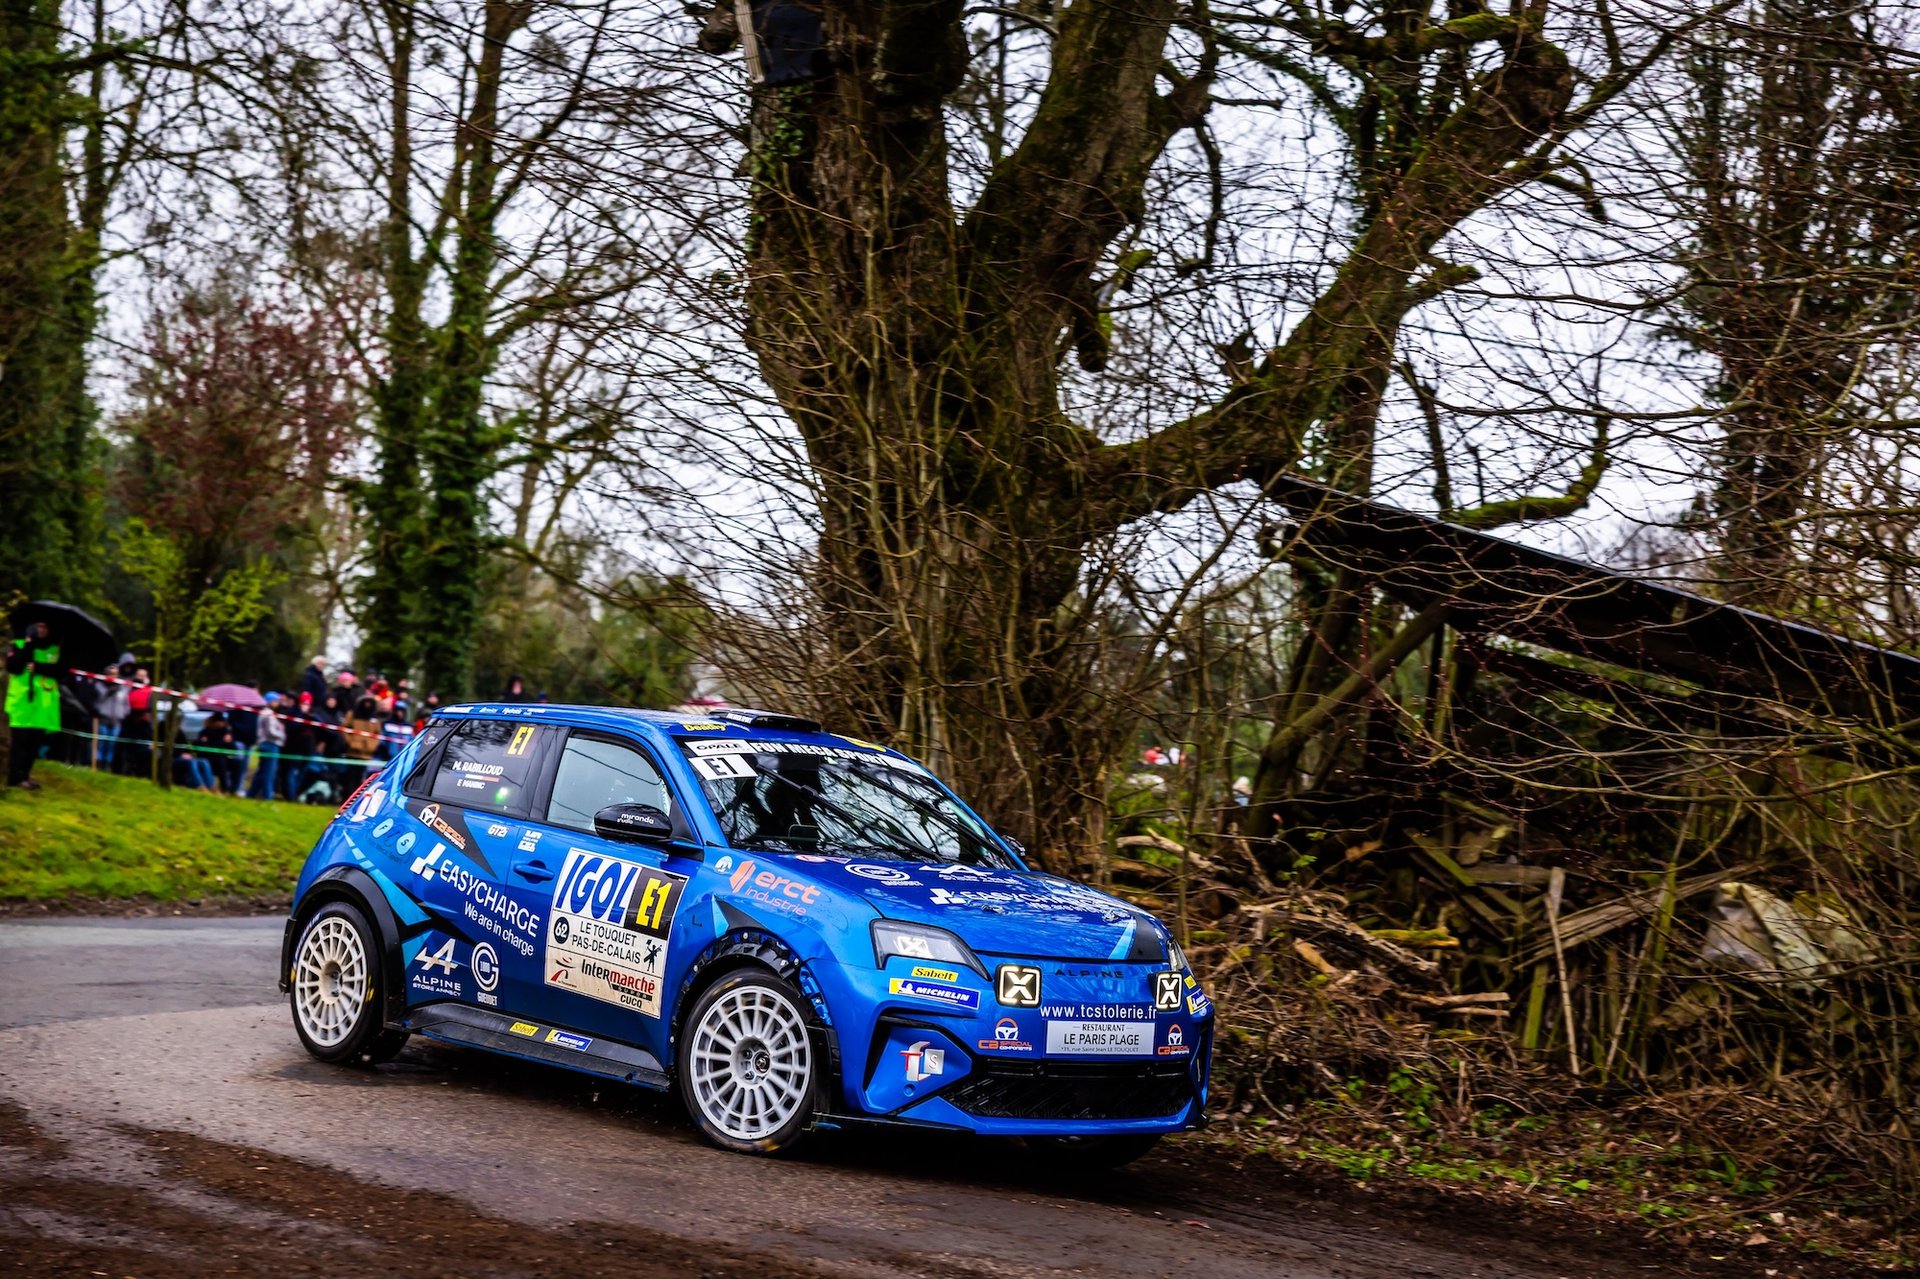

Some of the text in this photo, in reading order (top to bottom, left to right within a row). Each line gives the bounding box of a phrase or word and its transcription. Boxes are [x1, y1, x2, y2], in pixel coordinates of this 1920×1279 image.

[507, 726, 536, 755] E1
[750, 742, 789, 753] FUN
[462, 761, 504, 775] RABILLOUD
[702, 757, 739, 776] E1
[621, 813, 655, 825] miranda
[555, 854, 673, 930] IGOL E1
[754, 869, 821, 905] erct
[440, 859, 540, 938] EASYCHARGE
[744, 886, 807, 916] industrie
[464, 901, 534, 956] We are in charge
[555, 921, 568, 939] 62
[579, 921, 637, 947] LE TOUQUET
[571, 934, 641, 964] PAS-DE-CALAIS
[412, 974, 462, 991] ALPINE
[581, 958, 655, 994] Intermarché
[915, 967, 954, 981] Sabelt
[1055, 969, 1124, 979] ALPINE
[620, 994, 643, 1008] CUCQ
[915, 986, 970, 1002] MICHELIN
[1040, 1004, 1157, 1019] www.tcstolerie.fr
[1082, 1023, 1125, 1032] RESTAURANT
[1064, 1033, 1140, 1046] LE PARIS PLAGE
